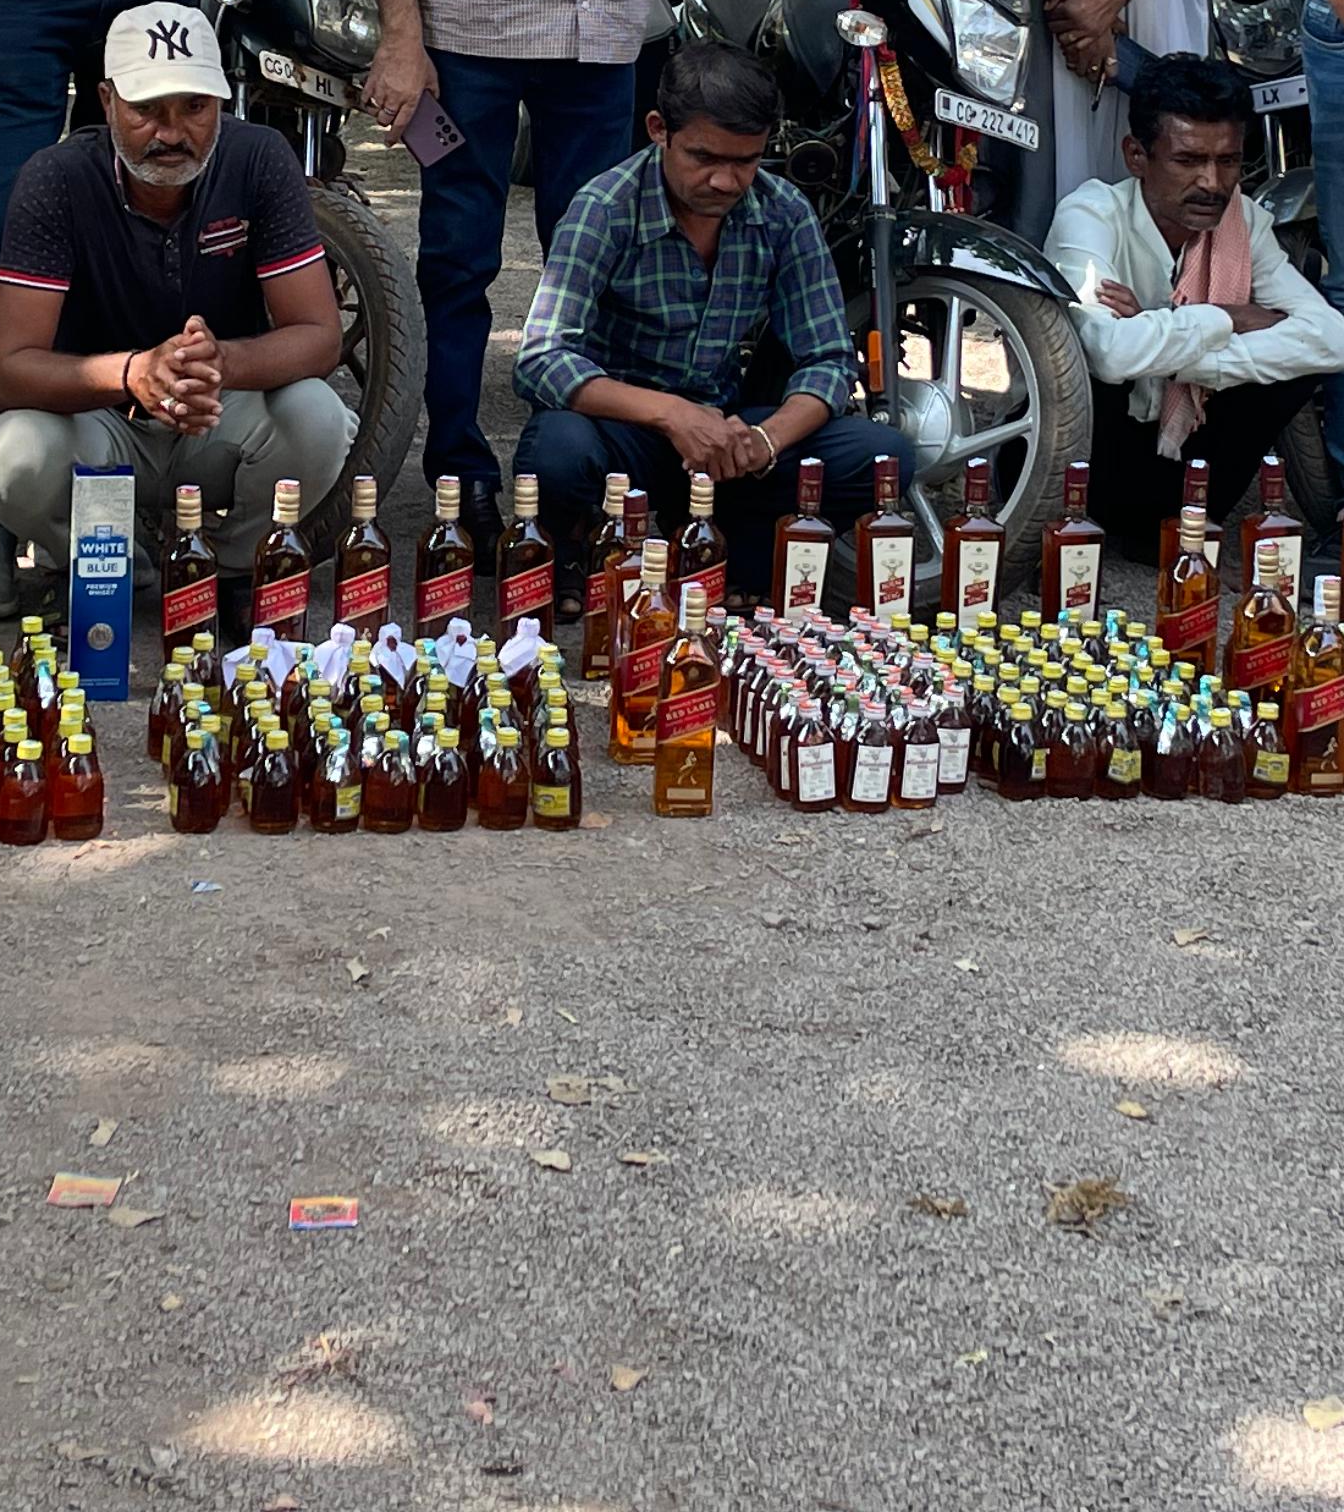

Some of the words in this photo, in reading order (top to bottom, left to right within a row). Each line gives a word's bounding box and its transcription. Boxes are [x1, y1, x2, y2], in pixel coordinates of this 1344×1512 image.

[145, 19, 193, 60] NY
[316, 75, 335, 97] HL
[1261, 89, 1280, 105] LX
[81, 542, 126, 554] WHITE
[87, 563, 119, 573] BLUE
[260, 595, 278, 606] RED
[279, 586, 307, 600] LABEL
[341, 590, 359, 601] RED
[361, 579, 388, 594] LABEL
[425, 590, 443, 601] RED
[444, 580, 471, 594] LABEL
[506, 587, 524, 599] RED
[524, 577, 552, 592] LABEL
[168, 601, 186, 614] RED
[186, 590, 215, 607] LABEL
[1266, 649, 1287, 663] LABE
[632, 661, 651, 673] RED
[666, 709, 686, 721] RED
[686, 699, 716, 715] LABEL
